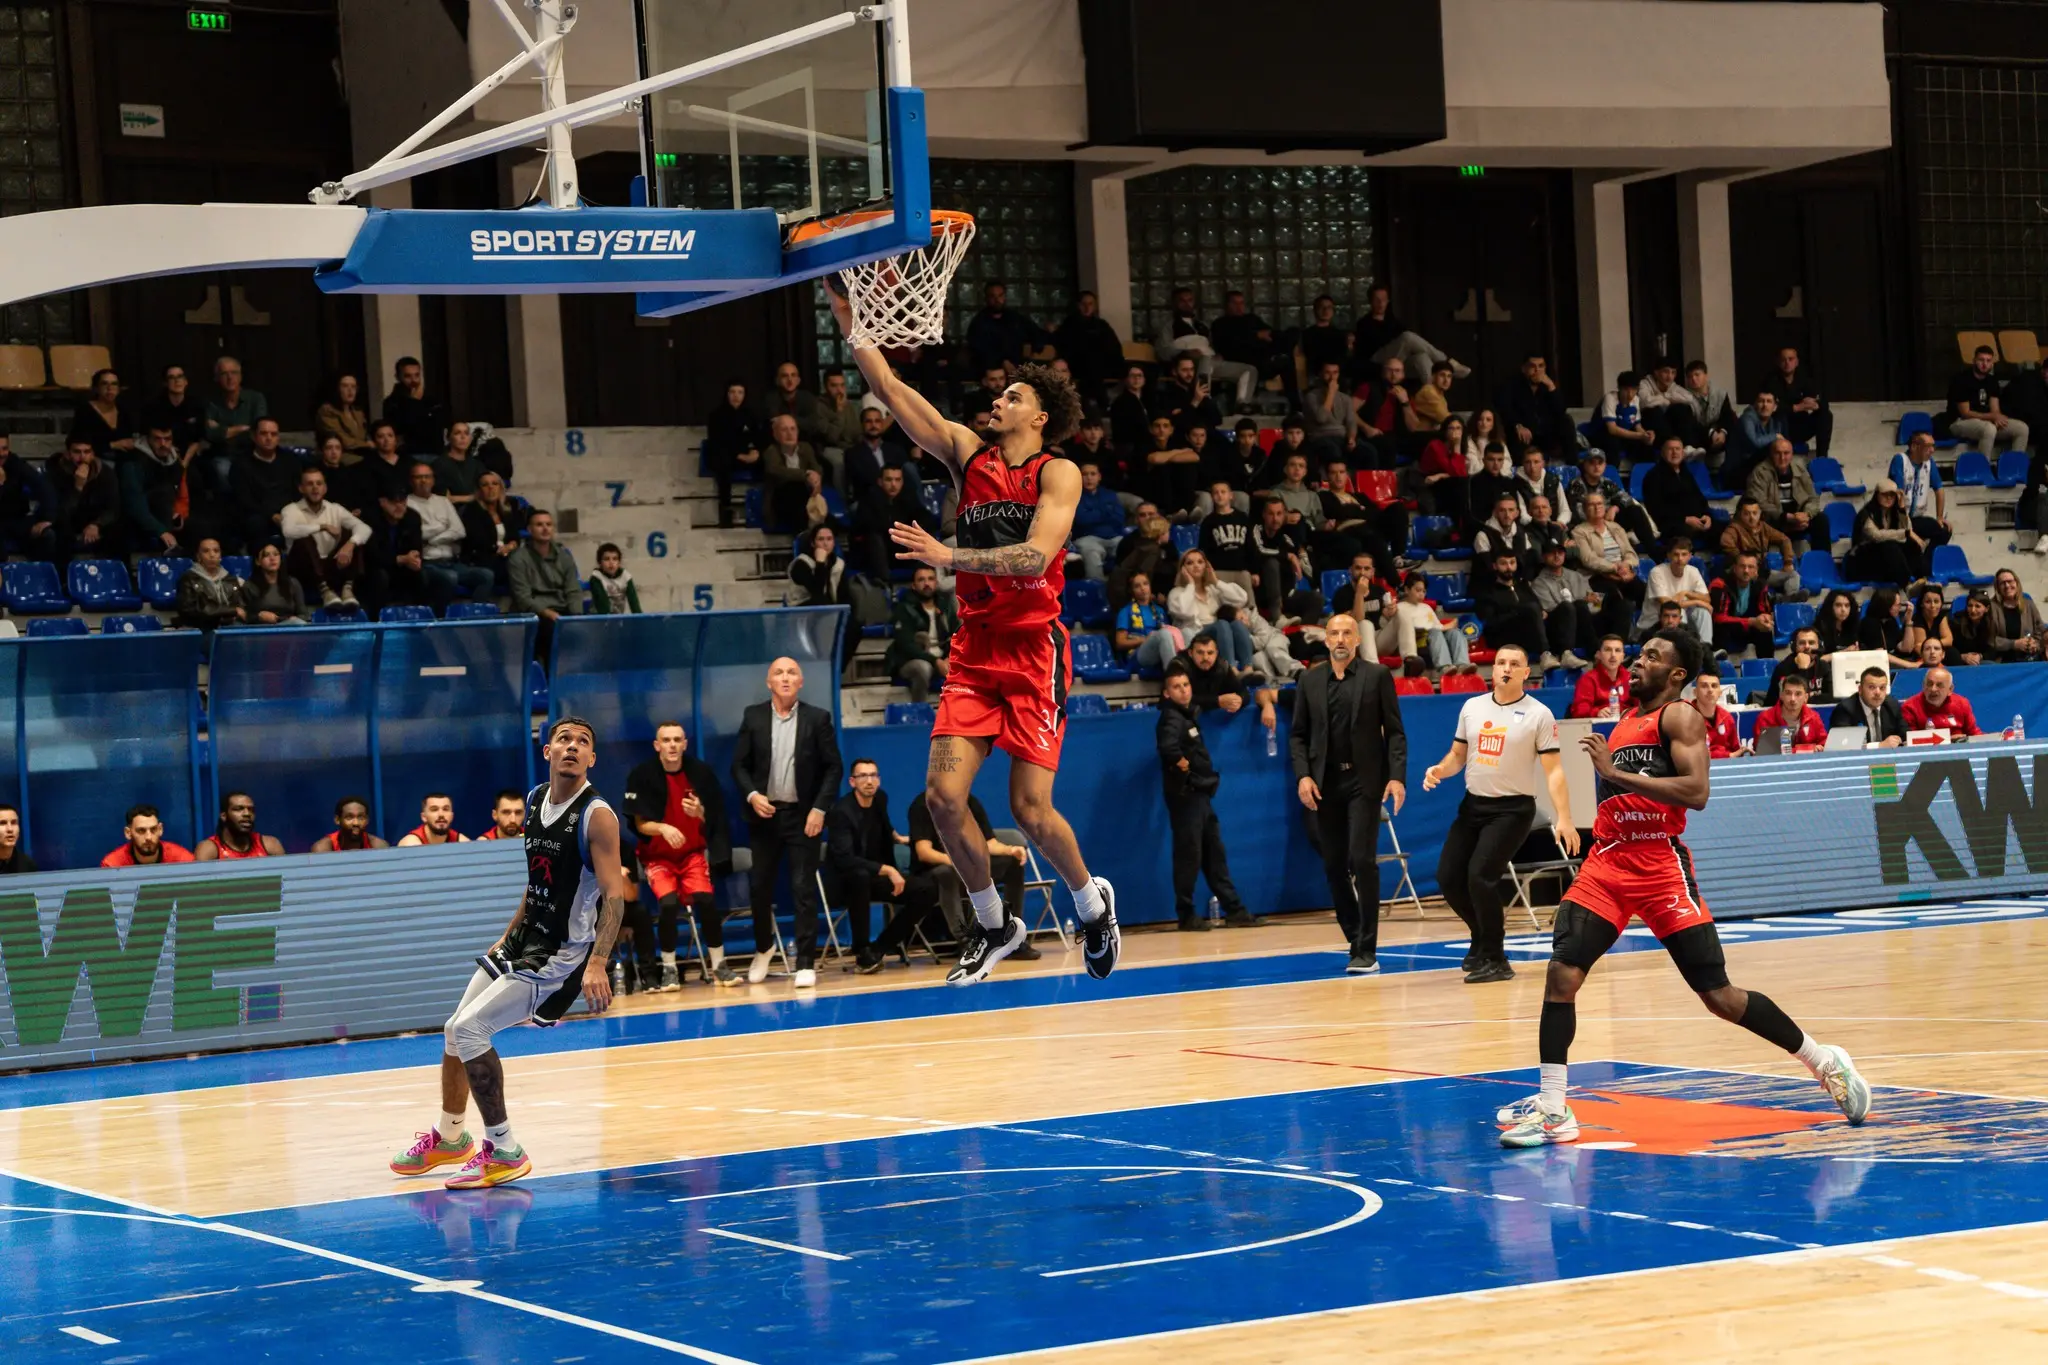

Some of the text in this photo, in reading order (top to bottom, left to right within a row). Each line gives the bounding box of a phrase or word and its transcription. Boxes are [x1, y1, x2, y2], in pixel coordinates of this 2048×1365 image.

[190, 12, 227, 29] EXIT
[565, 429, 587, 456] 8
[604, 481, 627, 507] 7
[646, 531, 669, 559] 6
[1212, 523, 1248, 547] PARIS
[693, 584, 715, 611] 5
